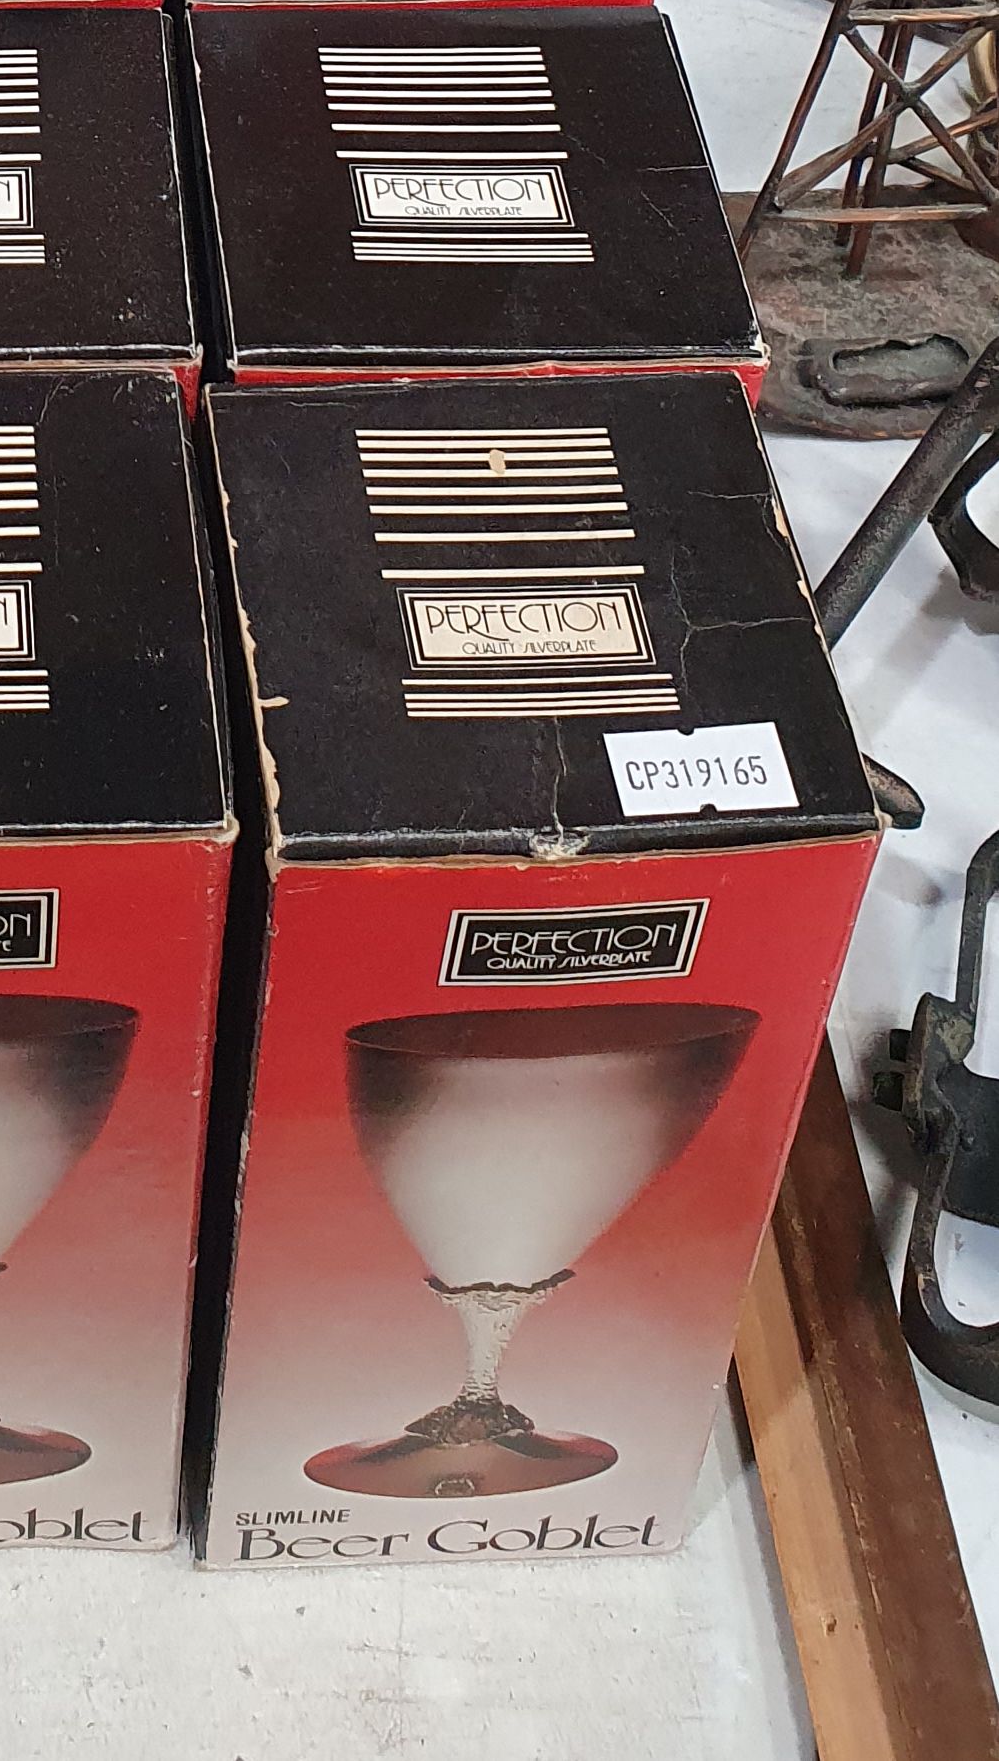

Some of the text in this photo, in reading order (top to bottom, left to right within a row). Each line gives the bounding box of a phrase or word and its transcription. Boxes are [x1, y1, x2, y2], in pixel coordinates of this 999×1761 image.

[374, 178, 545, 206] PERFECTION
[425, 601, 621, 641] PERFECTION
[462, 639, 597, 655] QUALITY SILVERPLATE
[625, 756, 767, 790] CP319165
[471, 923, 677, 958] PERFECTION
[487, 950, 652, 969] QUALITY SILVERPLATE
[235, 1509, 351, 1526] SLIMLINE
[234, 1513, 666, 1561] Beer Goblet
